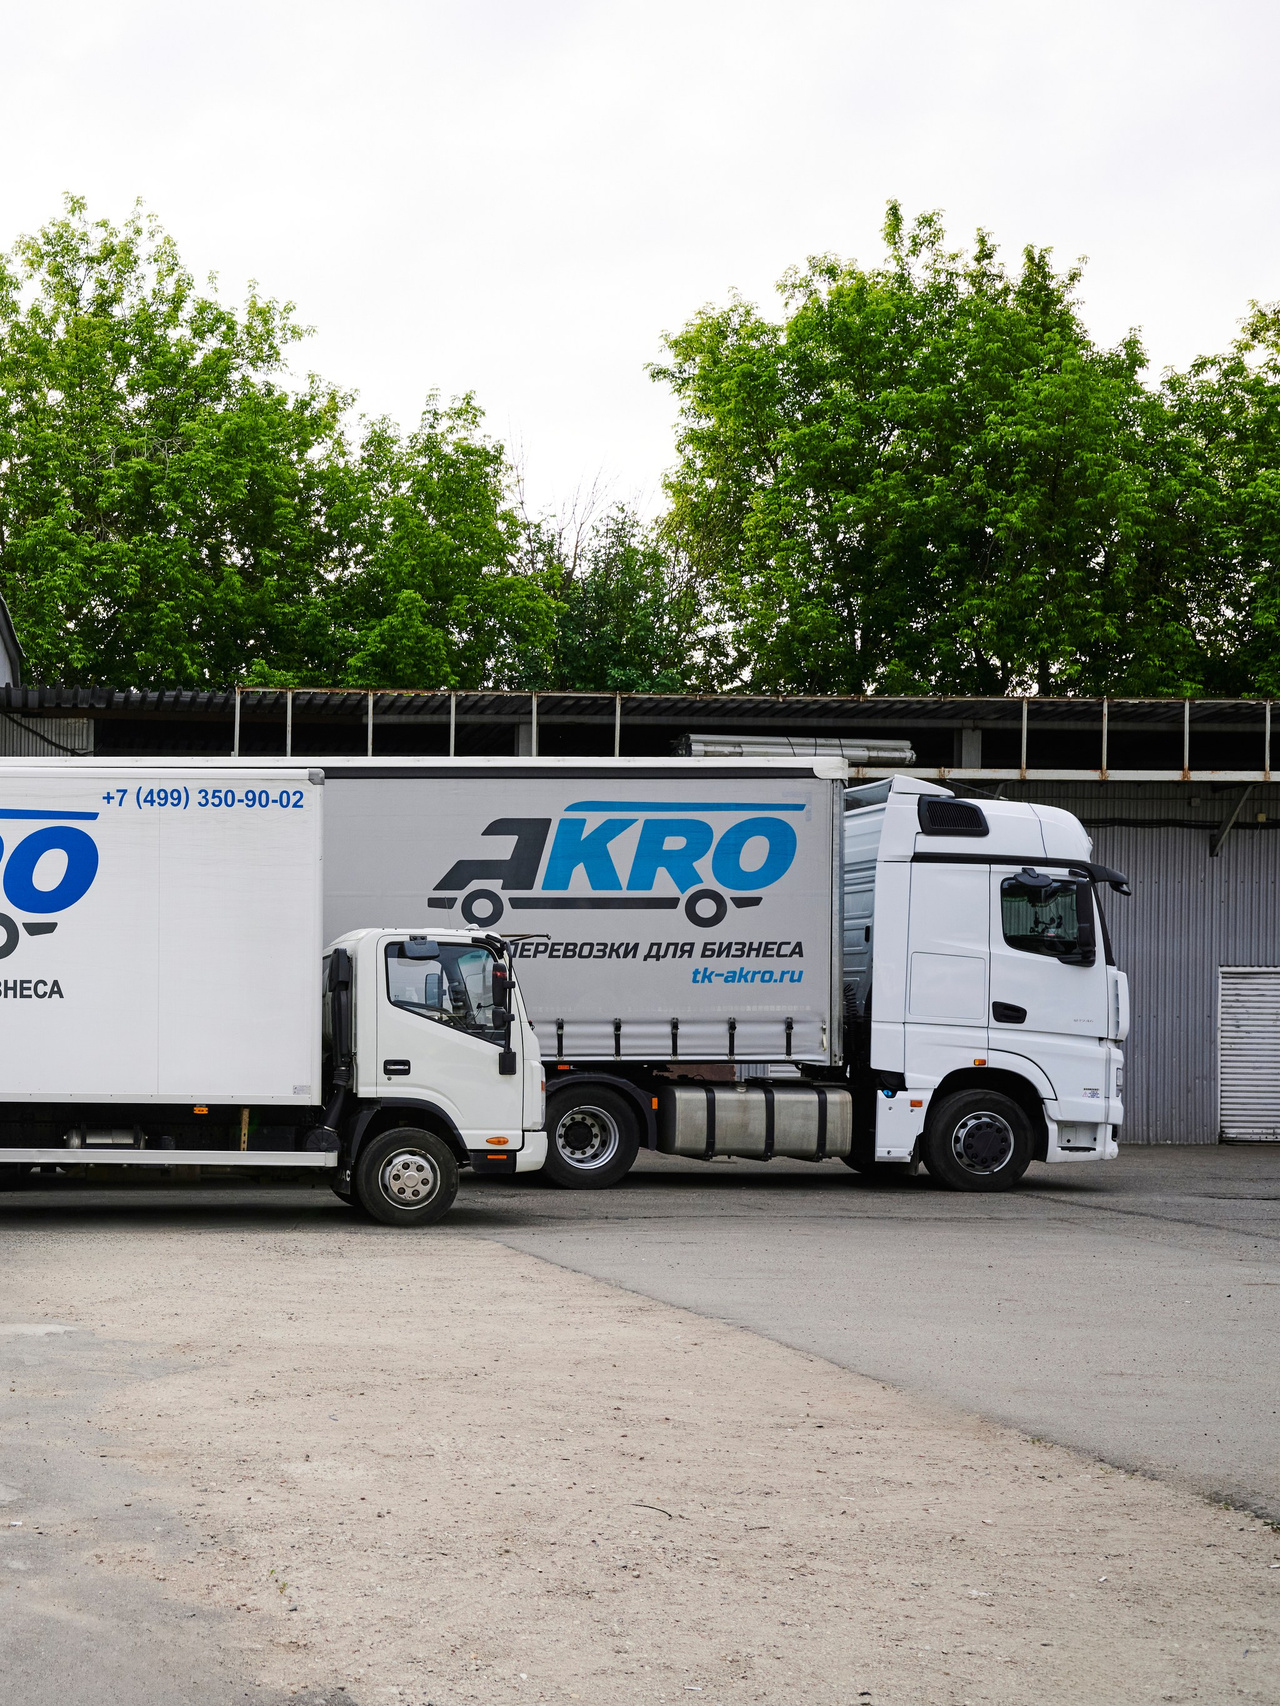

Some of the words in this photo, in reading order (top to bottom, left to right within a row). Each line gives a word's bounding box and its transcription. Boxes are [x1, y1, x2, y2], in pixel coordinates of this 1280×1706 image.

[102, 789, 129, 808] +7
[136, 786, 190, 811] (499)
[197, 789, 304, 809] 350-90-02
[643, 941, 696, 962] ДЛЯ
[700, 941, 804, 959] БИЗНЕСА
[691, 966, 805, 984] tk-akro.ru
